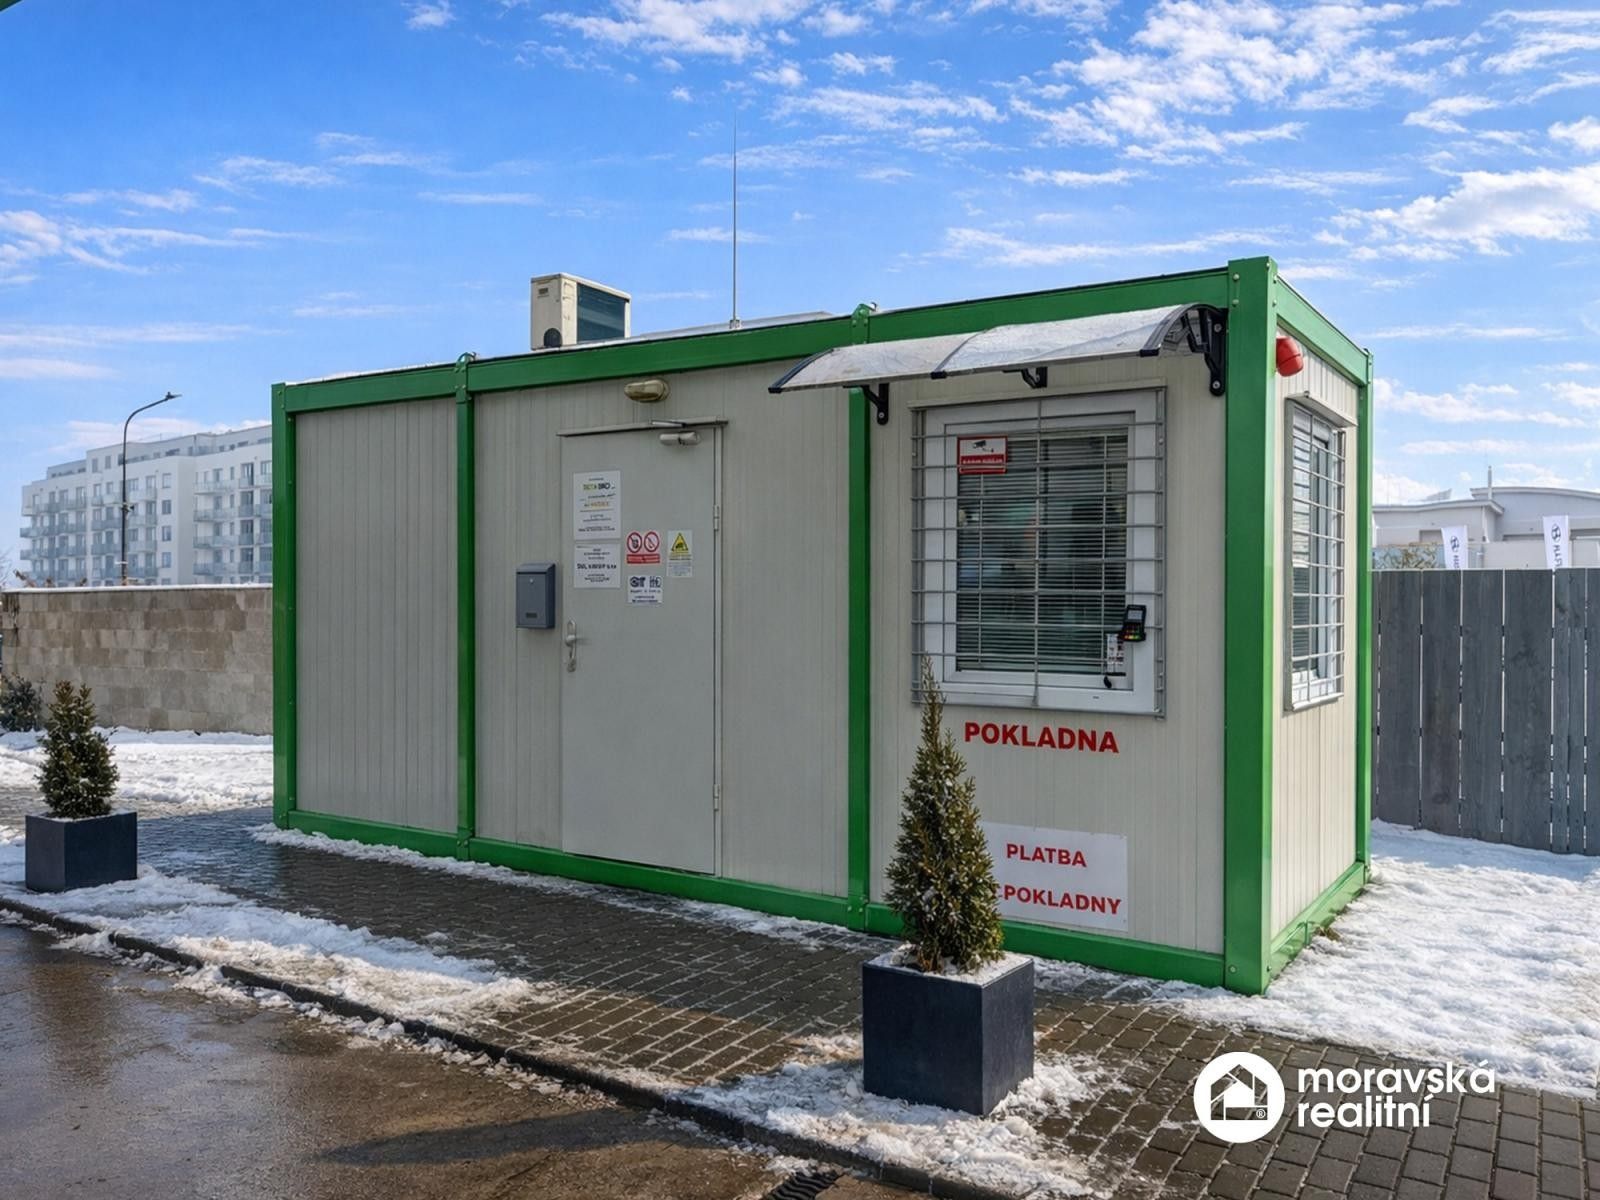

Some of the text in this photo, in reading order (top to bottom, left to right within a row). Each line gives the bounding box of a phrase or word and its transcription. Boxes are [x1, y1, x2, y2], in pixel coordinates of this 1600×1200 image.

[964, 722, 1119, 754] POKLADNA
[1006, 843, 1087, 867] PLATBA
[1003, 885, 1121, 915] POKLADNY
